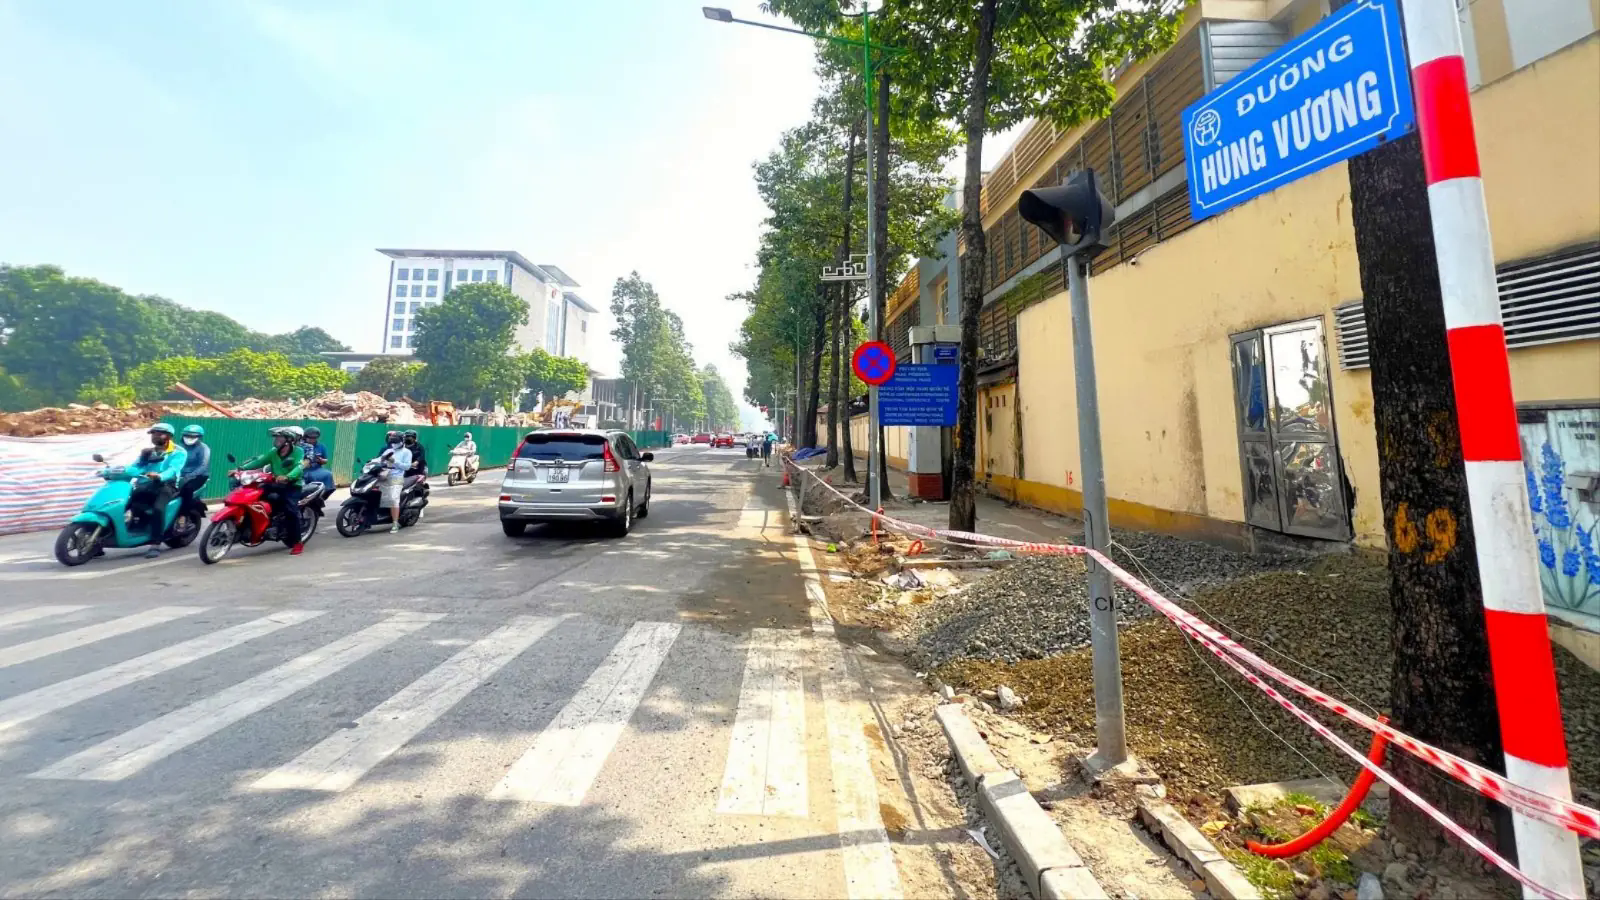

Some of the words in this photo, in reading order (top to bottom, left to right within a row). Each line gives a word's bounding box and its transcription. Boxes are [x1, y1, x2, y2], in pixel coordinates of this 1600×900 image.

[1235, 34, 1355, 118] ĐƯỜNG
[1200, 129, 1267, 194] HÙNG
[1271, 70, 1383, 160] VƯƠNG
